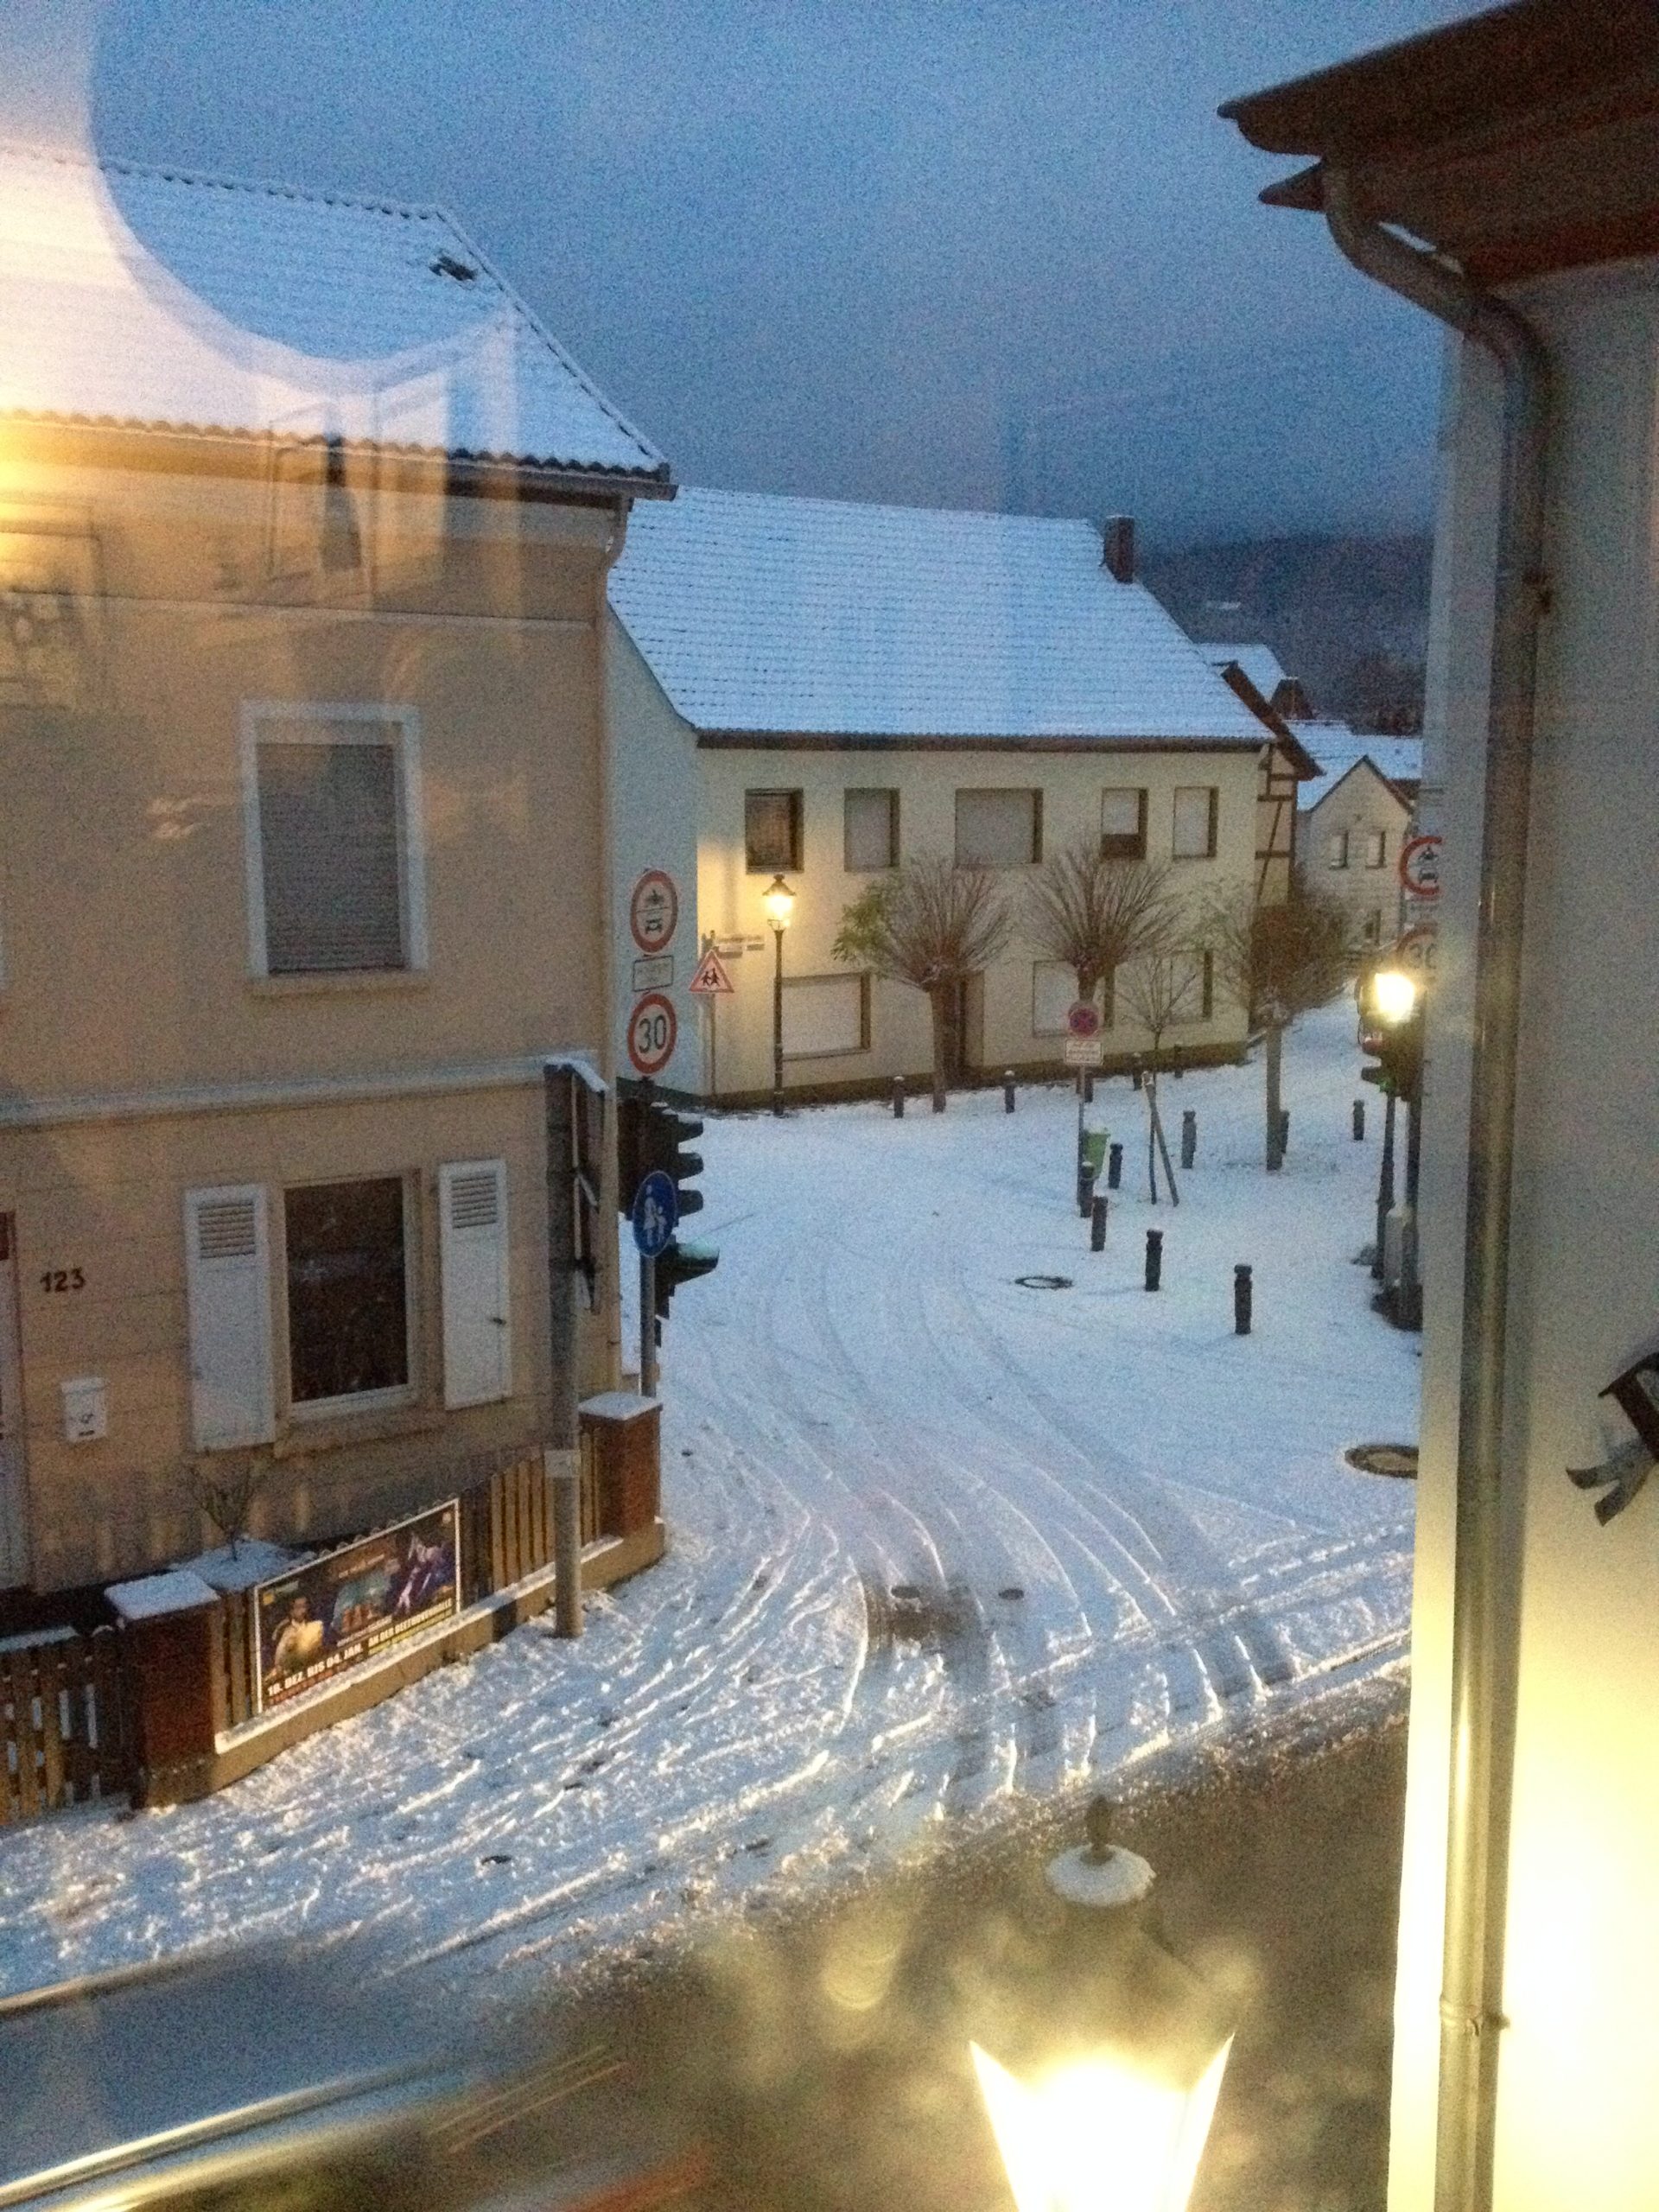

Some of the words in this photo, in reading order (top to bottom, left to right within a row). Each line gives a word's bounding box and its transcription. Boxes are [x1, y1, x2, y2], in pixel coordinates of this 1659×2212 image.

[639, 1014, 667, 1054] 30
[40, 1267, 86, 1292] 123
[307, 1661, 325, 1677] BIS
